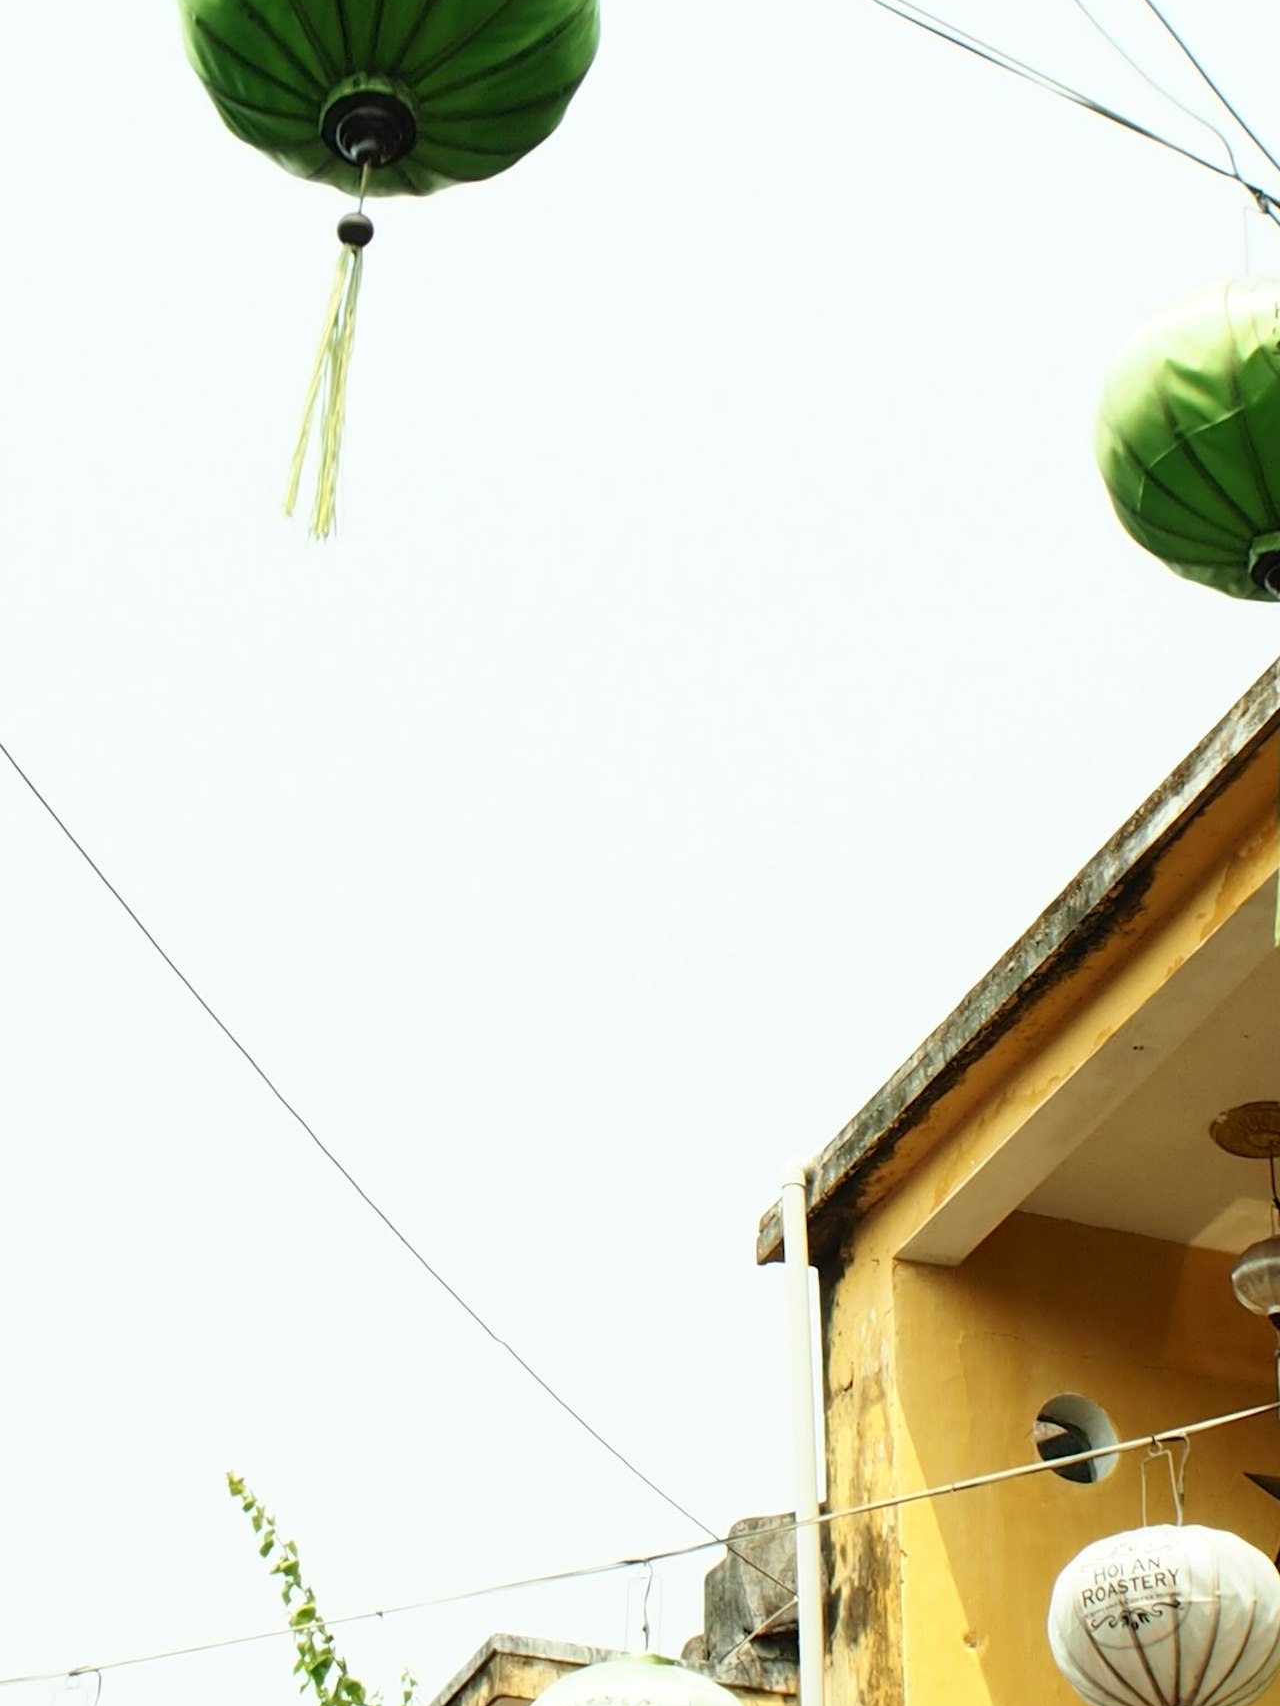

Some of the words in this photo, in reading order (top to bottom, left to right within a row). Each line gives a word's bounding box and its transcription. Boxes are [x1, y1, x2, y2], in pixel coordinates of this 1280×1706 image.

[1081, 1567, 1180, 1609] ROASTERY
[1093, 1562, 1125, 1586] HOI
[1131, 1556, 1161, 1574] AN
